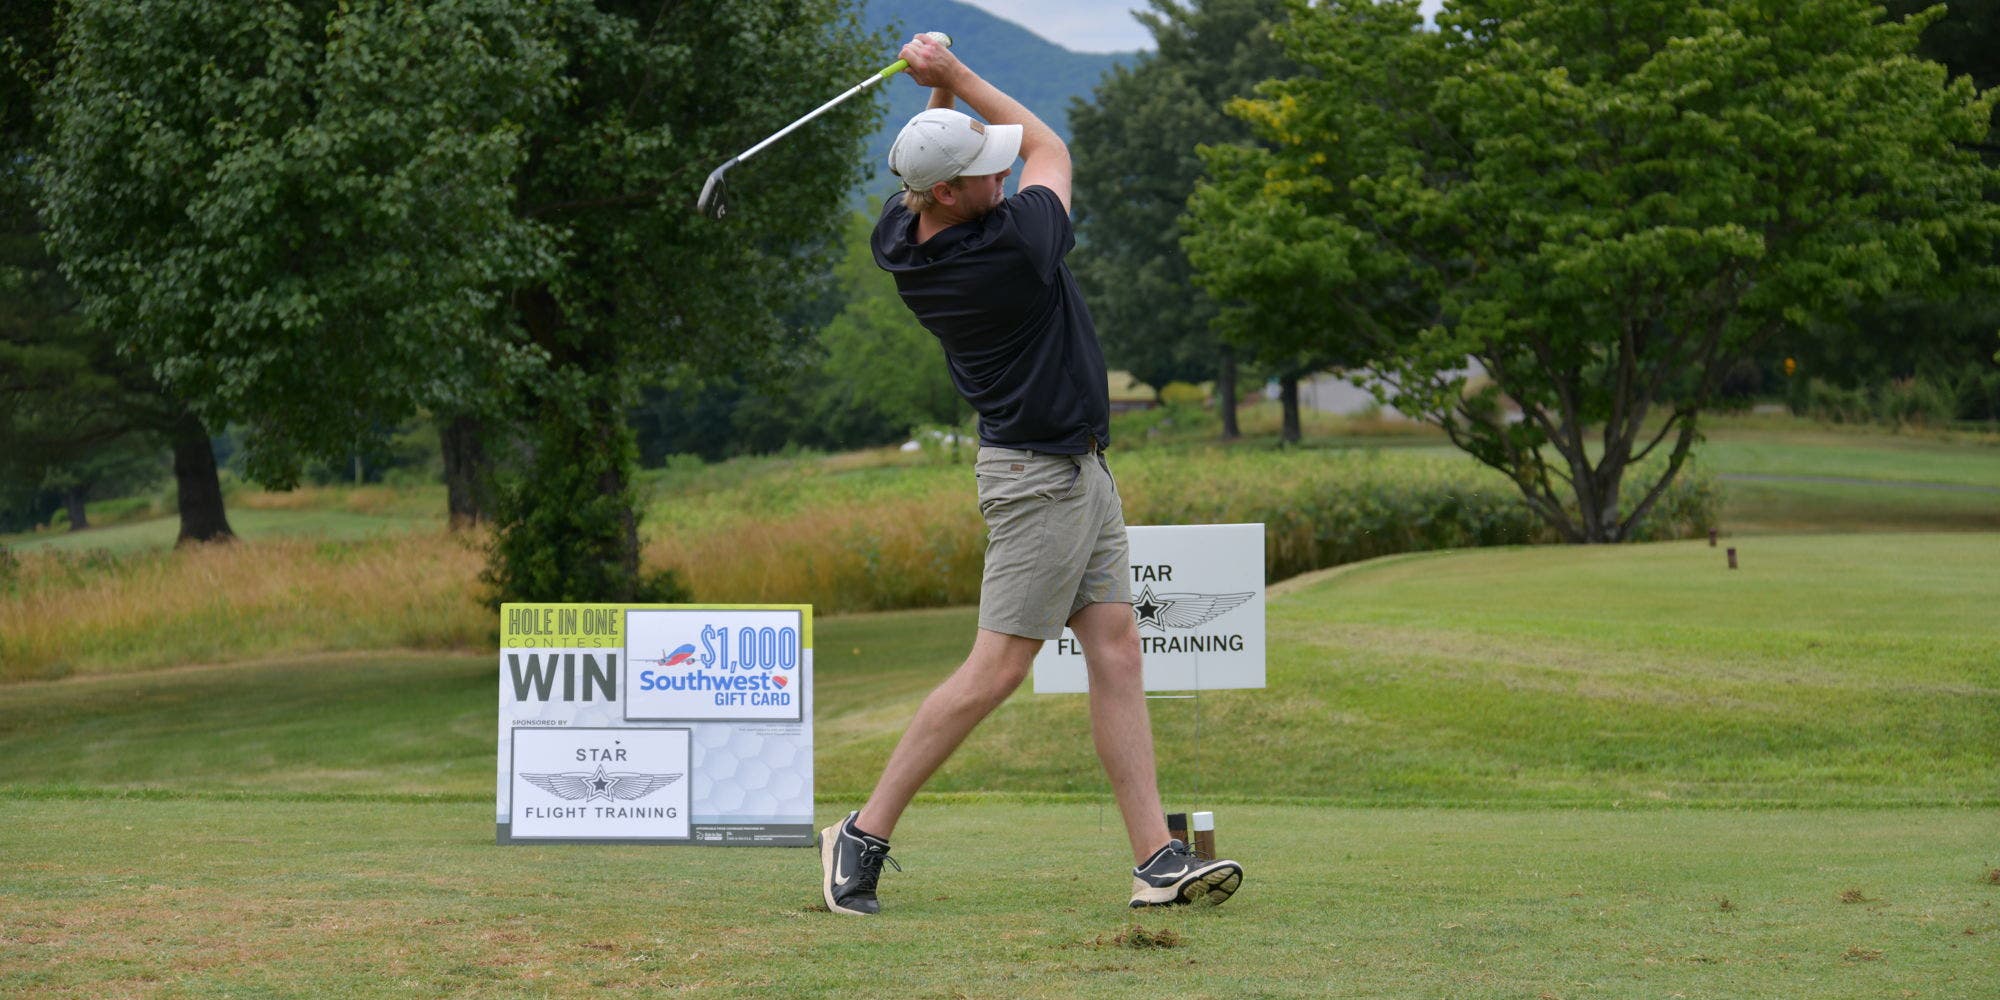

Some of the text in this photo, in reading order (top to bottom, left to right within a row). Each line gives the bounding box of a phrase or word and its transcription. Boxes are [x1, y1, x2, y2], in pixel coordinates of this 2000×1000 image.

[1130, 565, 1173, 582] TAR
[509, 608, 618, 635] HOLE IN ONE
[507, 637, 618, 648] CONTEST
[701, 624, 796, 673] $1,000
[1141, 634, 1244, 653] TRAINING
[508, 653, 617, 701] WIN
[640, 670, 771, 691] Southwest
[714, 692, 790, 706] GIFT CARD
[575, 748, 627, 762] STAR
[525, 807, 677, 819] FLIGHT TRAINING
